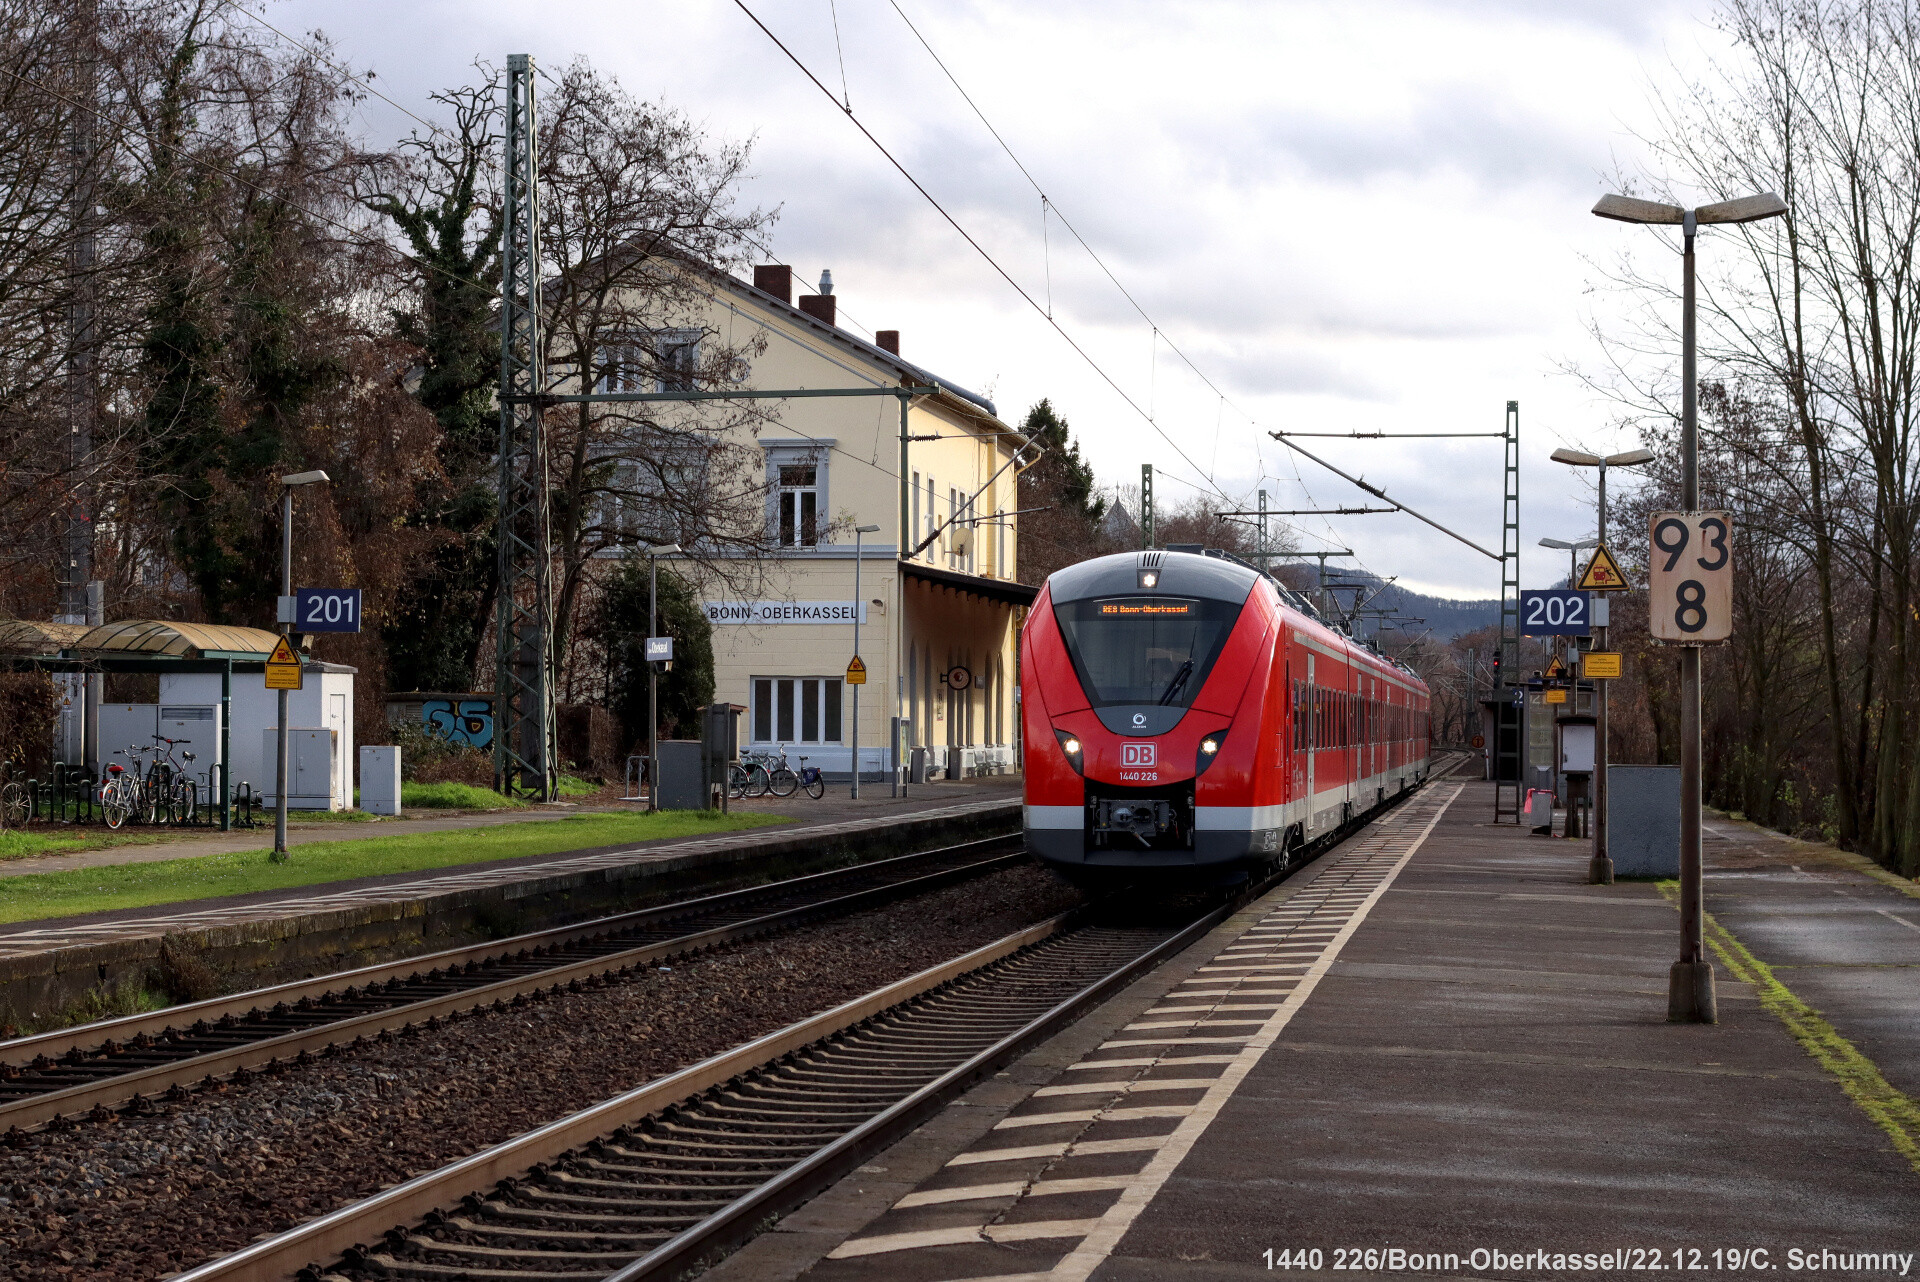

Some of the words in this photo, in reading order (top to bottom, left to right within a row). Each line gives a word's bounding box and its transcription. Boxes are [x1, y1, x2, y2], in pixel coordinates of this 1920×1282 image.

[1653, 517, 1729, 571] 93
[306, 595, 354, 623] 201
[1526, 596, 1584, 626] 202
[1674, 579, 1708, 633] 8
[1125, 746, 1153, 764] DB
[1119, 772, 1140, 781] 1440
[1141, 772, 1158, 781] 226
